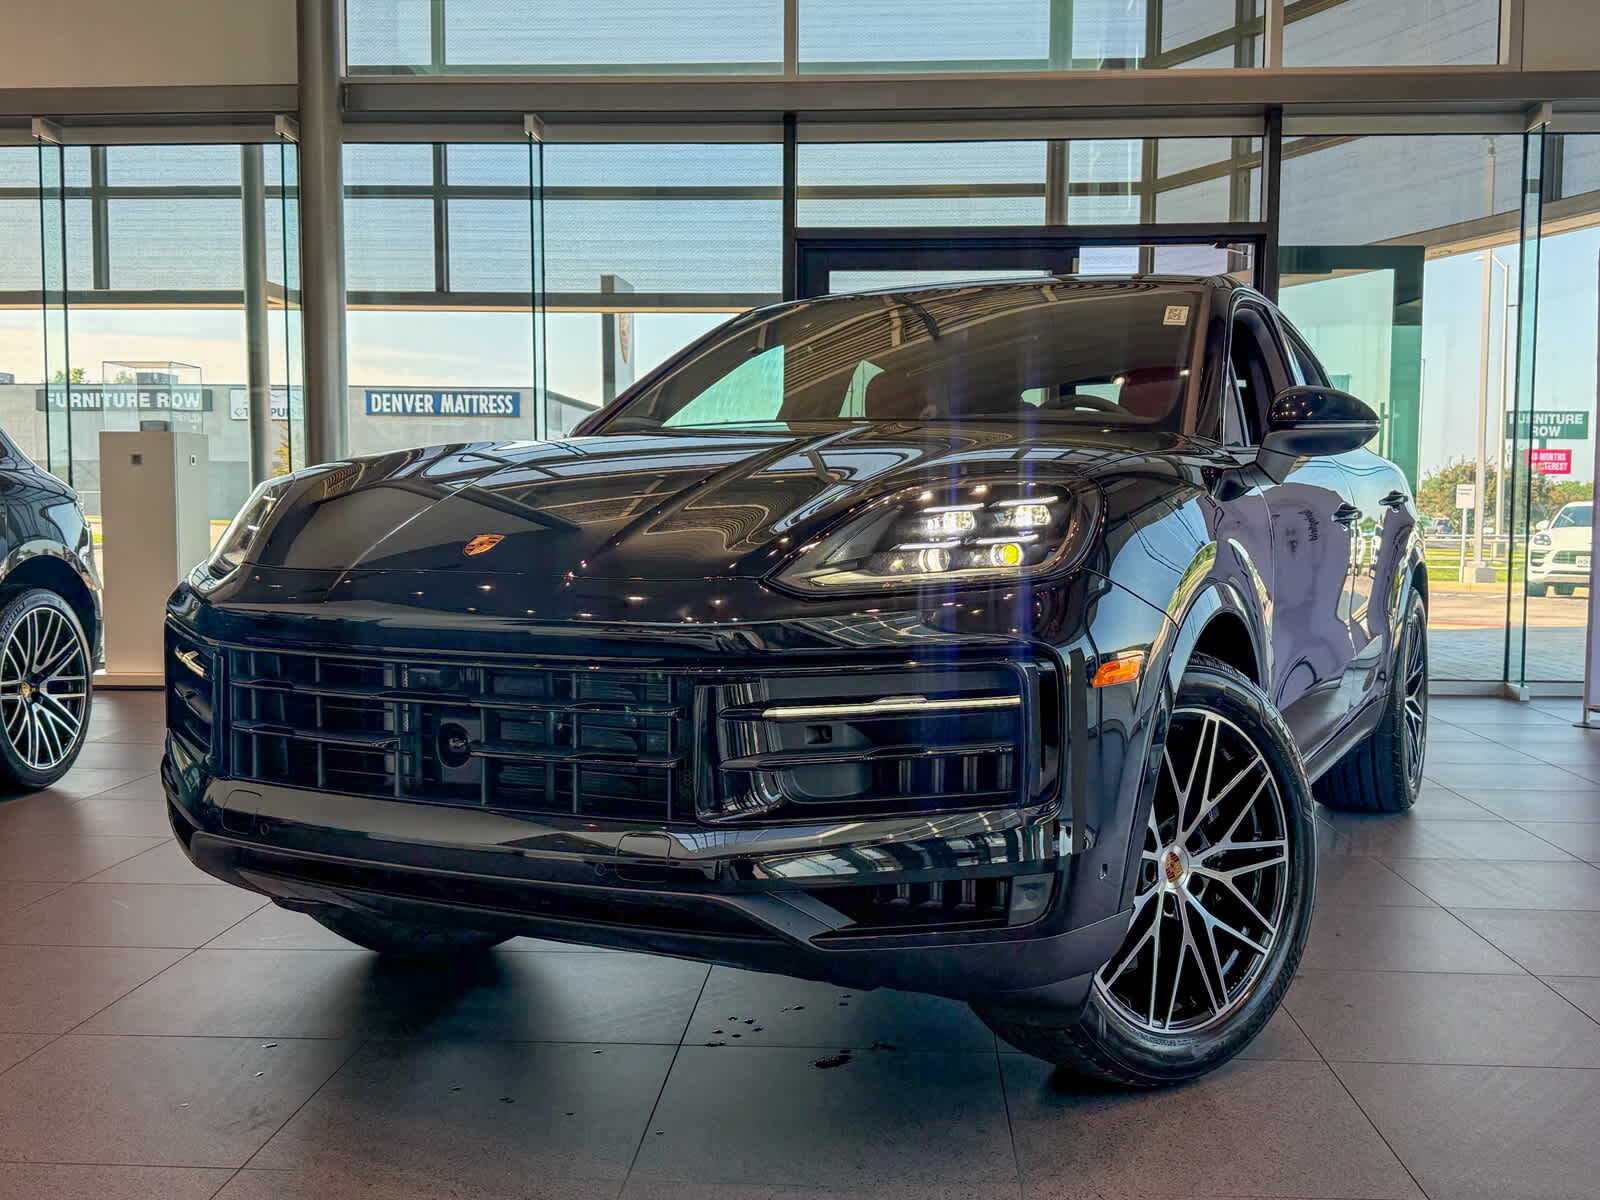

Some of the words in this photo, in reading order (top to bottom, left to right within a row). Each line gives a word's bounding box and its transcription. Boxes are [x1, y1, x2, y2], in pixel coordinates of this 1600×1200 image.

[48, 392, 150, 408] FURNITURE
[157, 393, 200, 408] ROW
[371, 393, 434, 412] DENVER
[440, 394, 513, 414] MATTRESS
